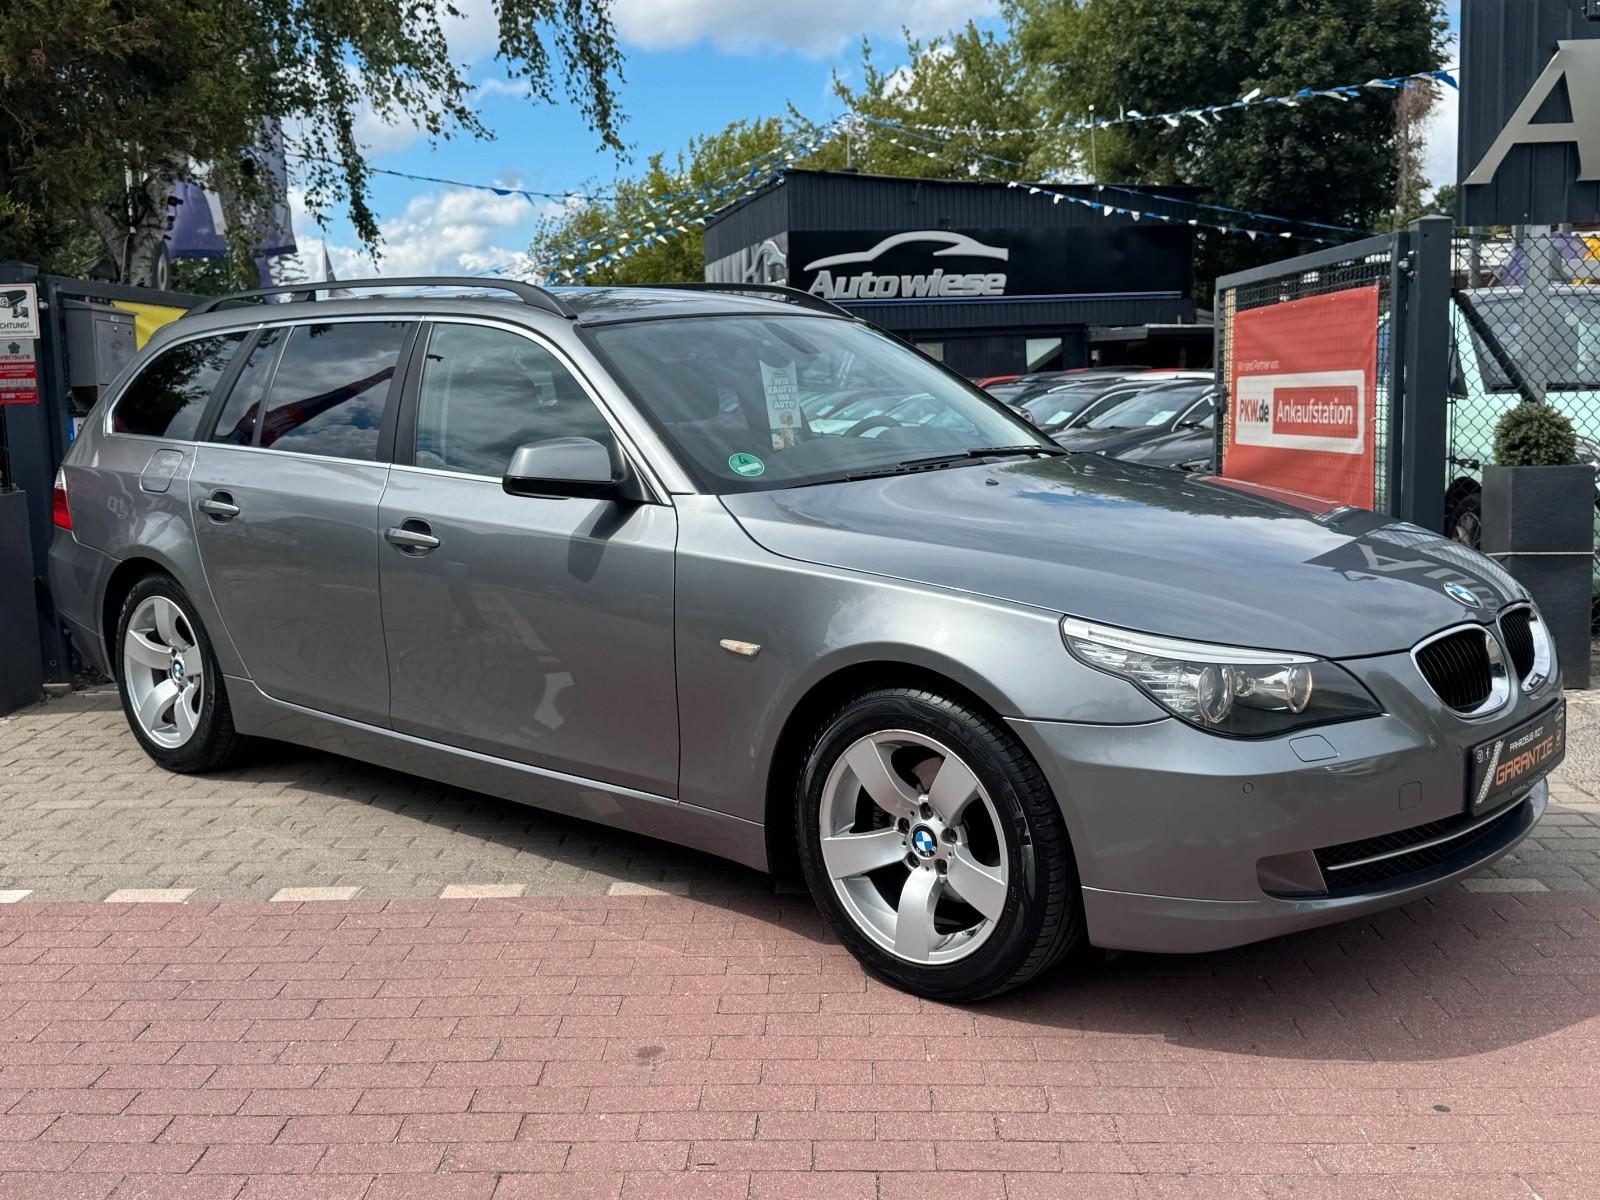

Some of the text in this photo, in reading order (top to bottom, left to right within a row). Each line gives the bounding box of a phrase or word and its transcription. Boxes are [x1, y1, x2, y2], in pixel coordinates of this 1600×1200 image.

[1240, 398, 1353, 425] PKW.de Ankaufstation
[1495, 735, 1554, 786] GARANTIE
